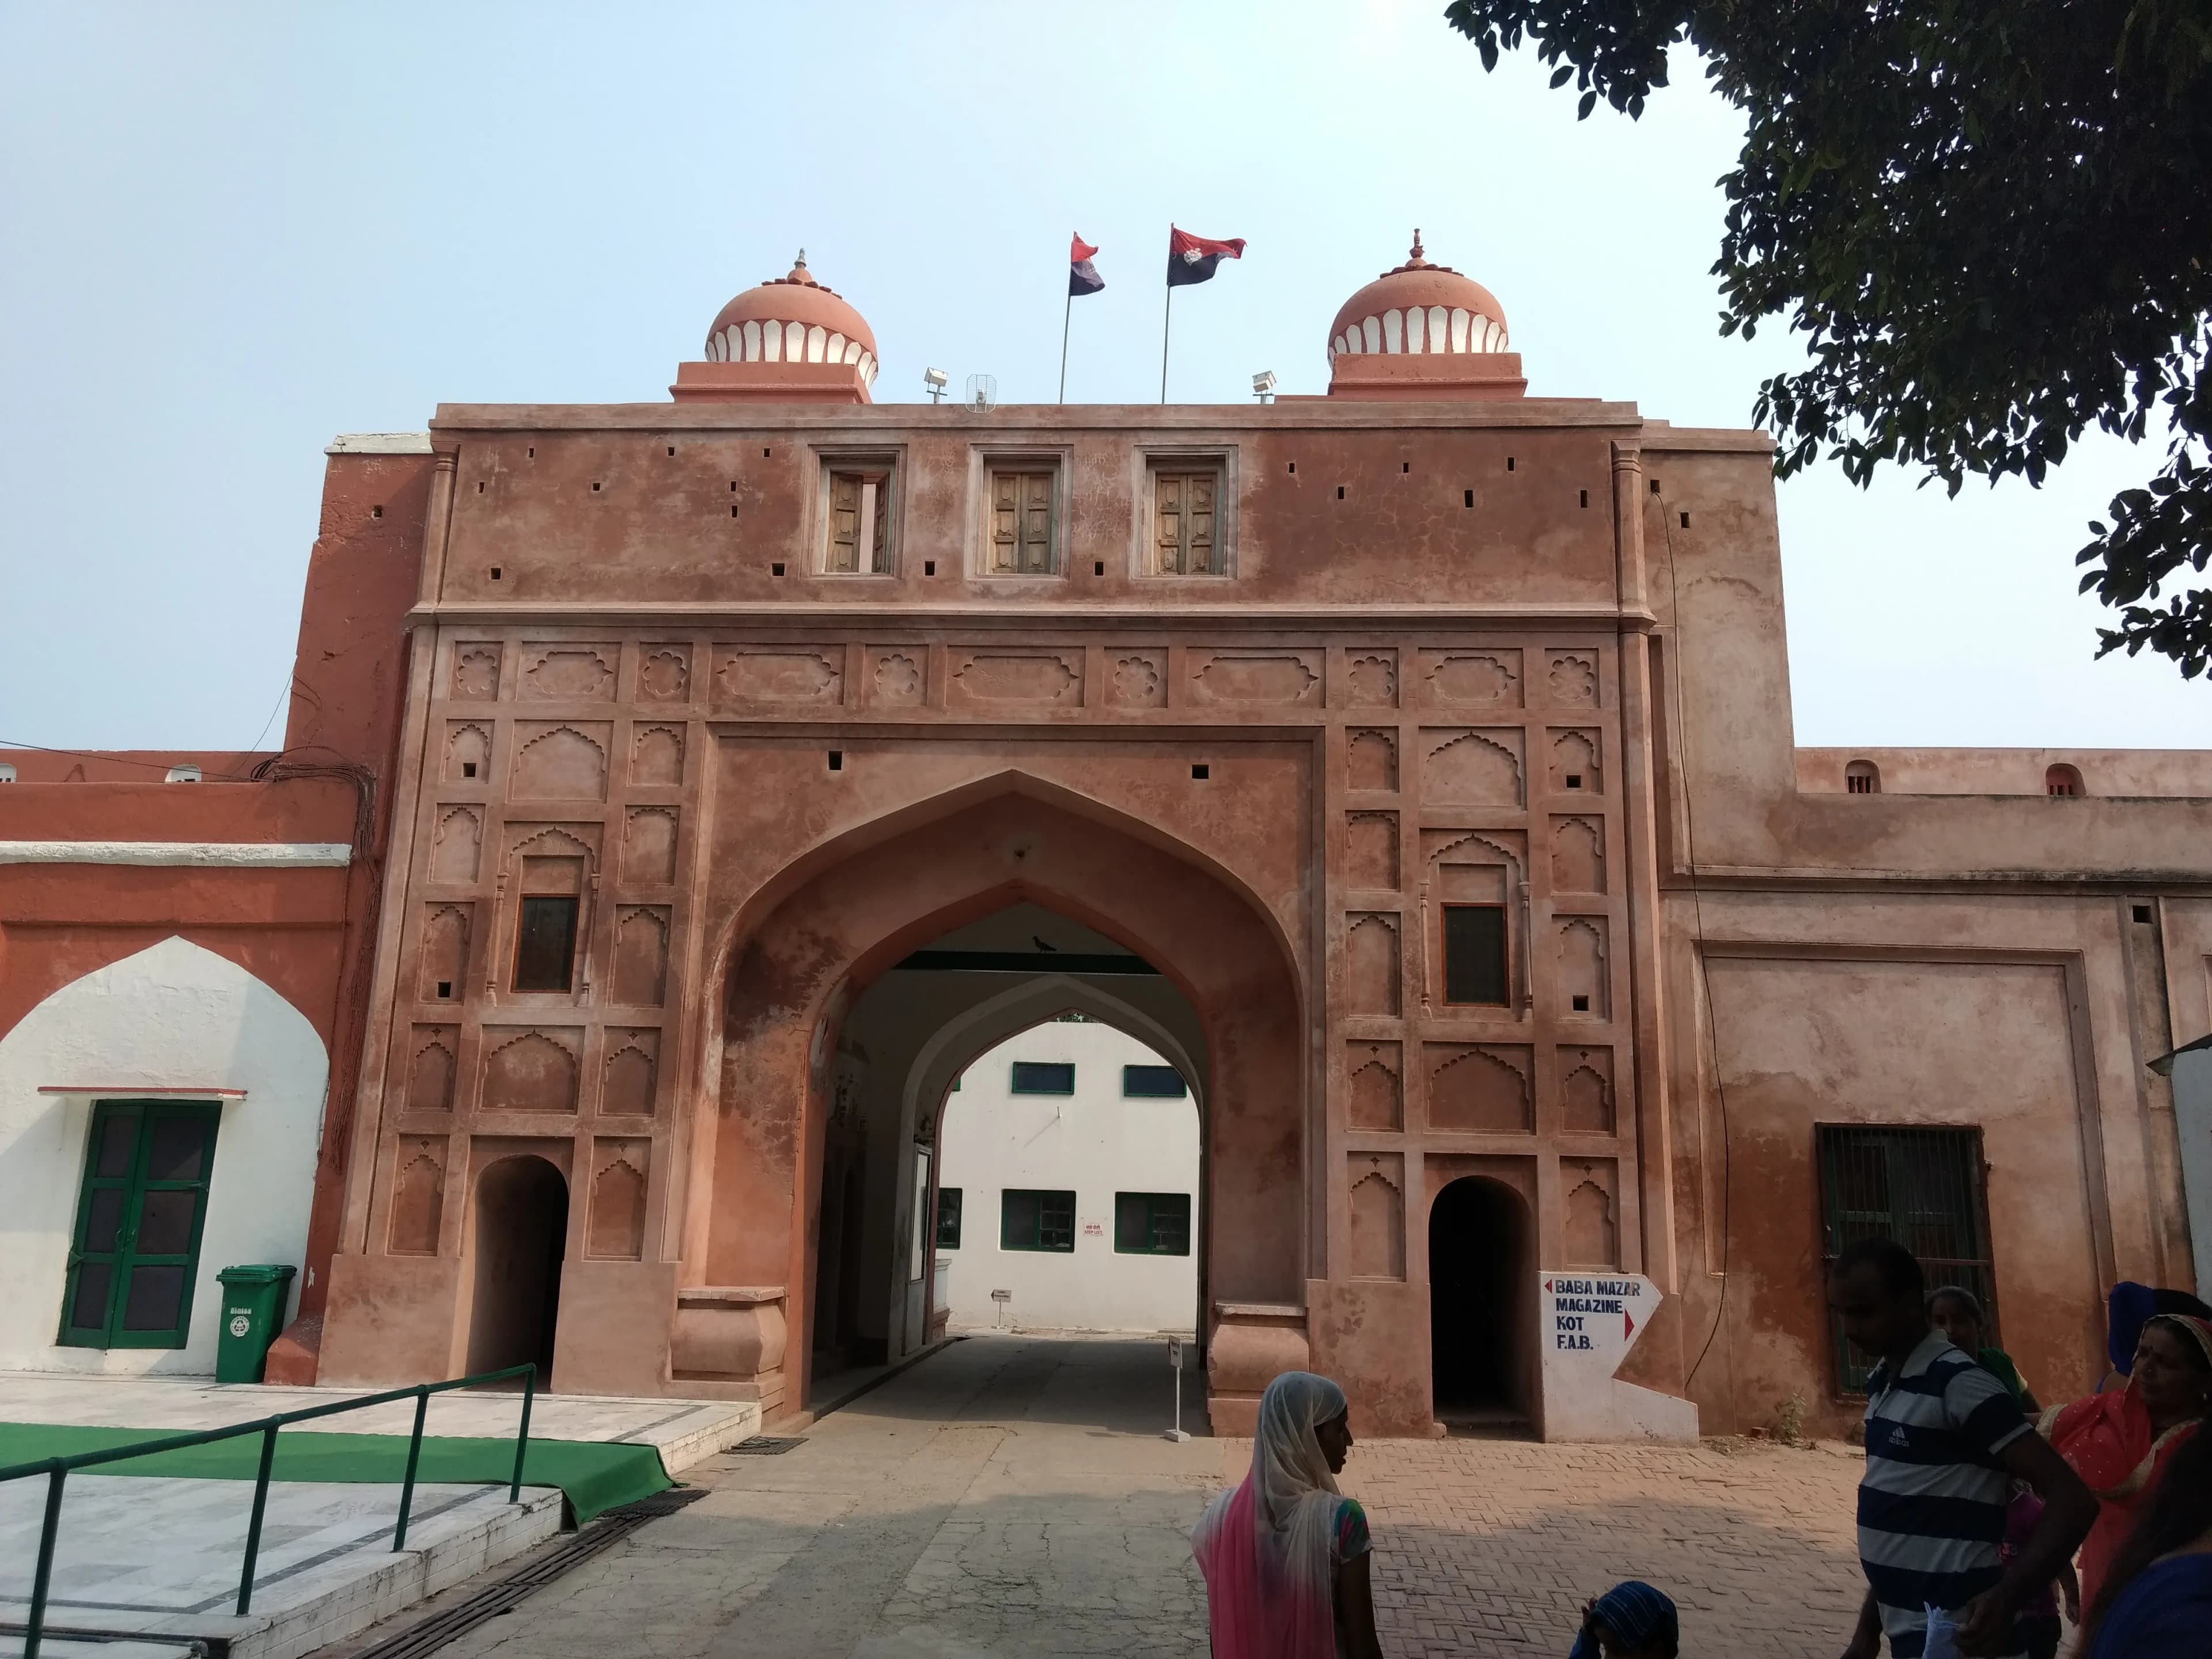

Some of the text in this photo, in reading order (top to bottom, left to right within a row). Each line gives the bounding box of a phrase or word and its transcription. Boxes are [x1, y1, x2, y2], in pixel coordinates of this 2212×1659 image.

[1555, 1280, 1641, 1296] BABA MAZAR
[1556, 1298, 1623, 1314] MAGAZINE
[1556, 1316, 1584, 1331] KOT
[1557, 1335, 1593, 1350] F.A.B.
